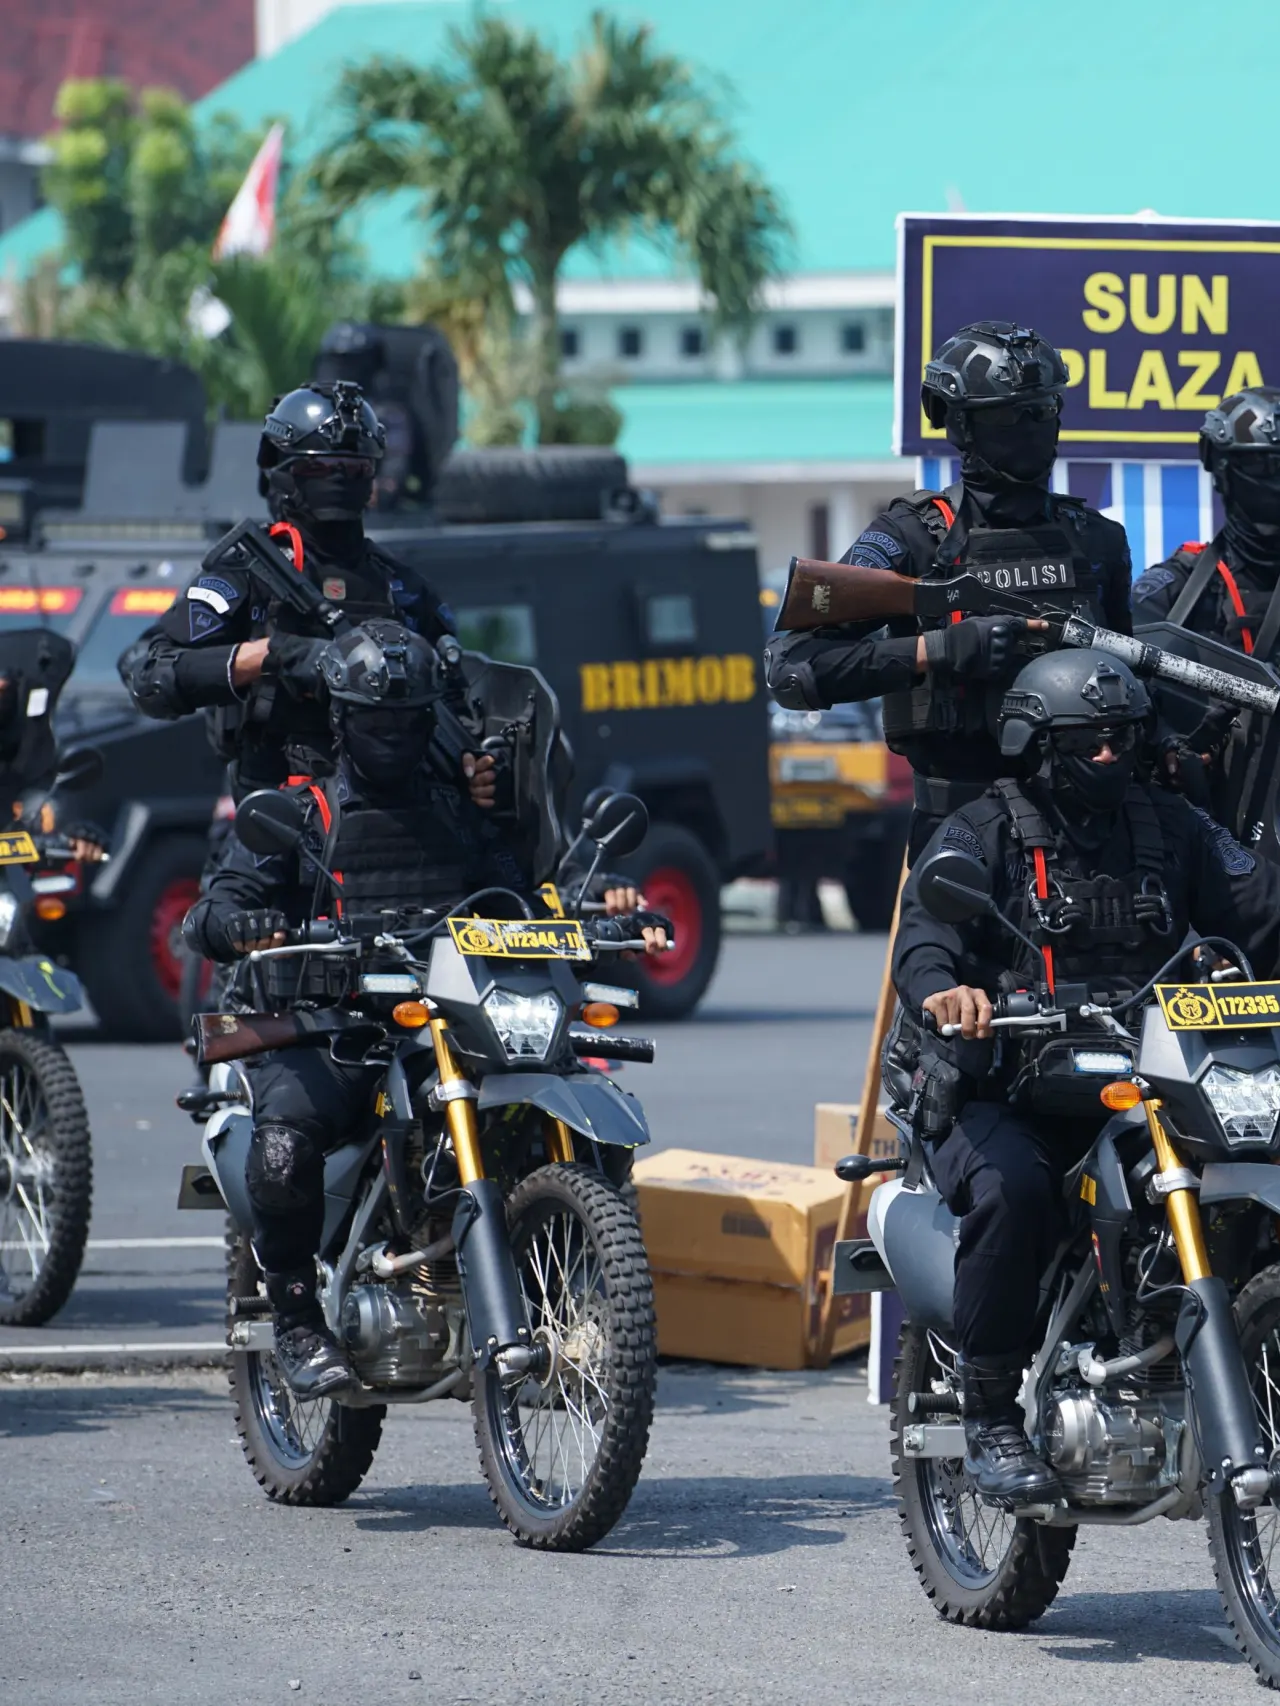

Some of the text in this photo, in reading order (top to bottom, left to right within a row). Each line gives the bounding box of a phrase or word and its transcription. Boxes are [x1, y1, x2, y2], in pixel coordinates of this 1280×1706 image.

[1082, 271, 1229, 335] SUN
[977, 564, 1067, 588] POLISI
[580, 654, 756, 712] BRIMOB
